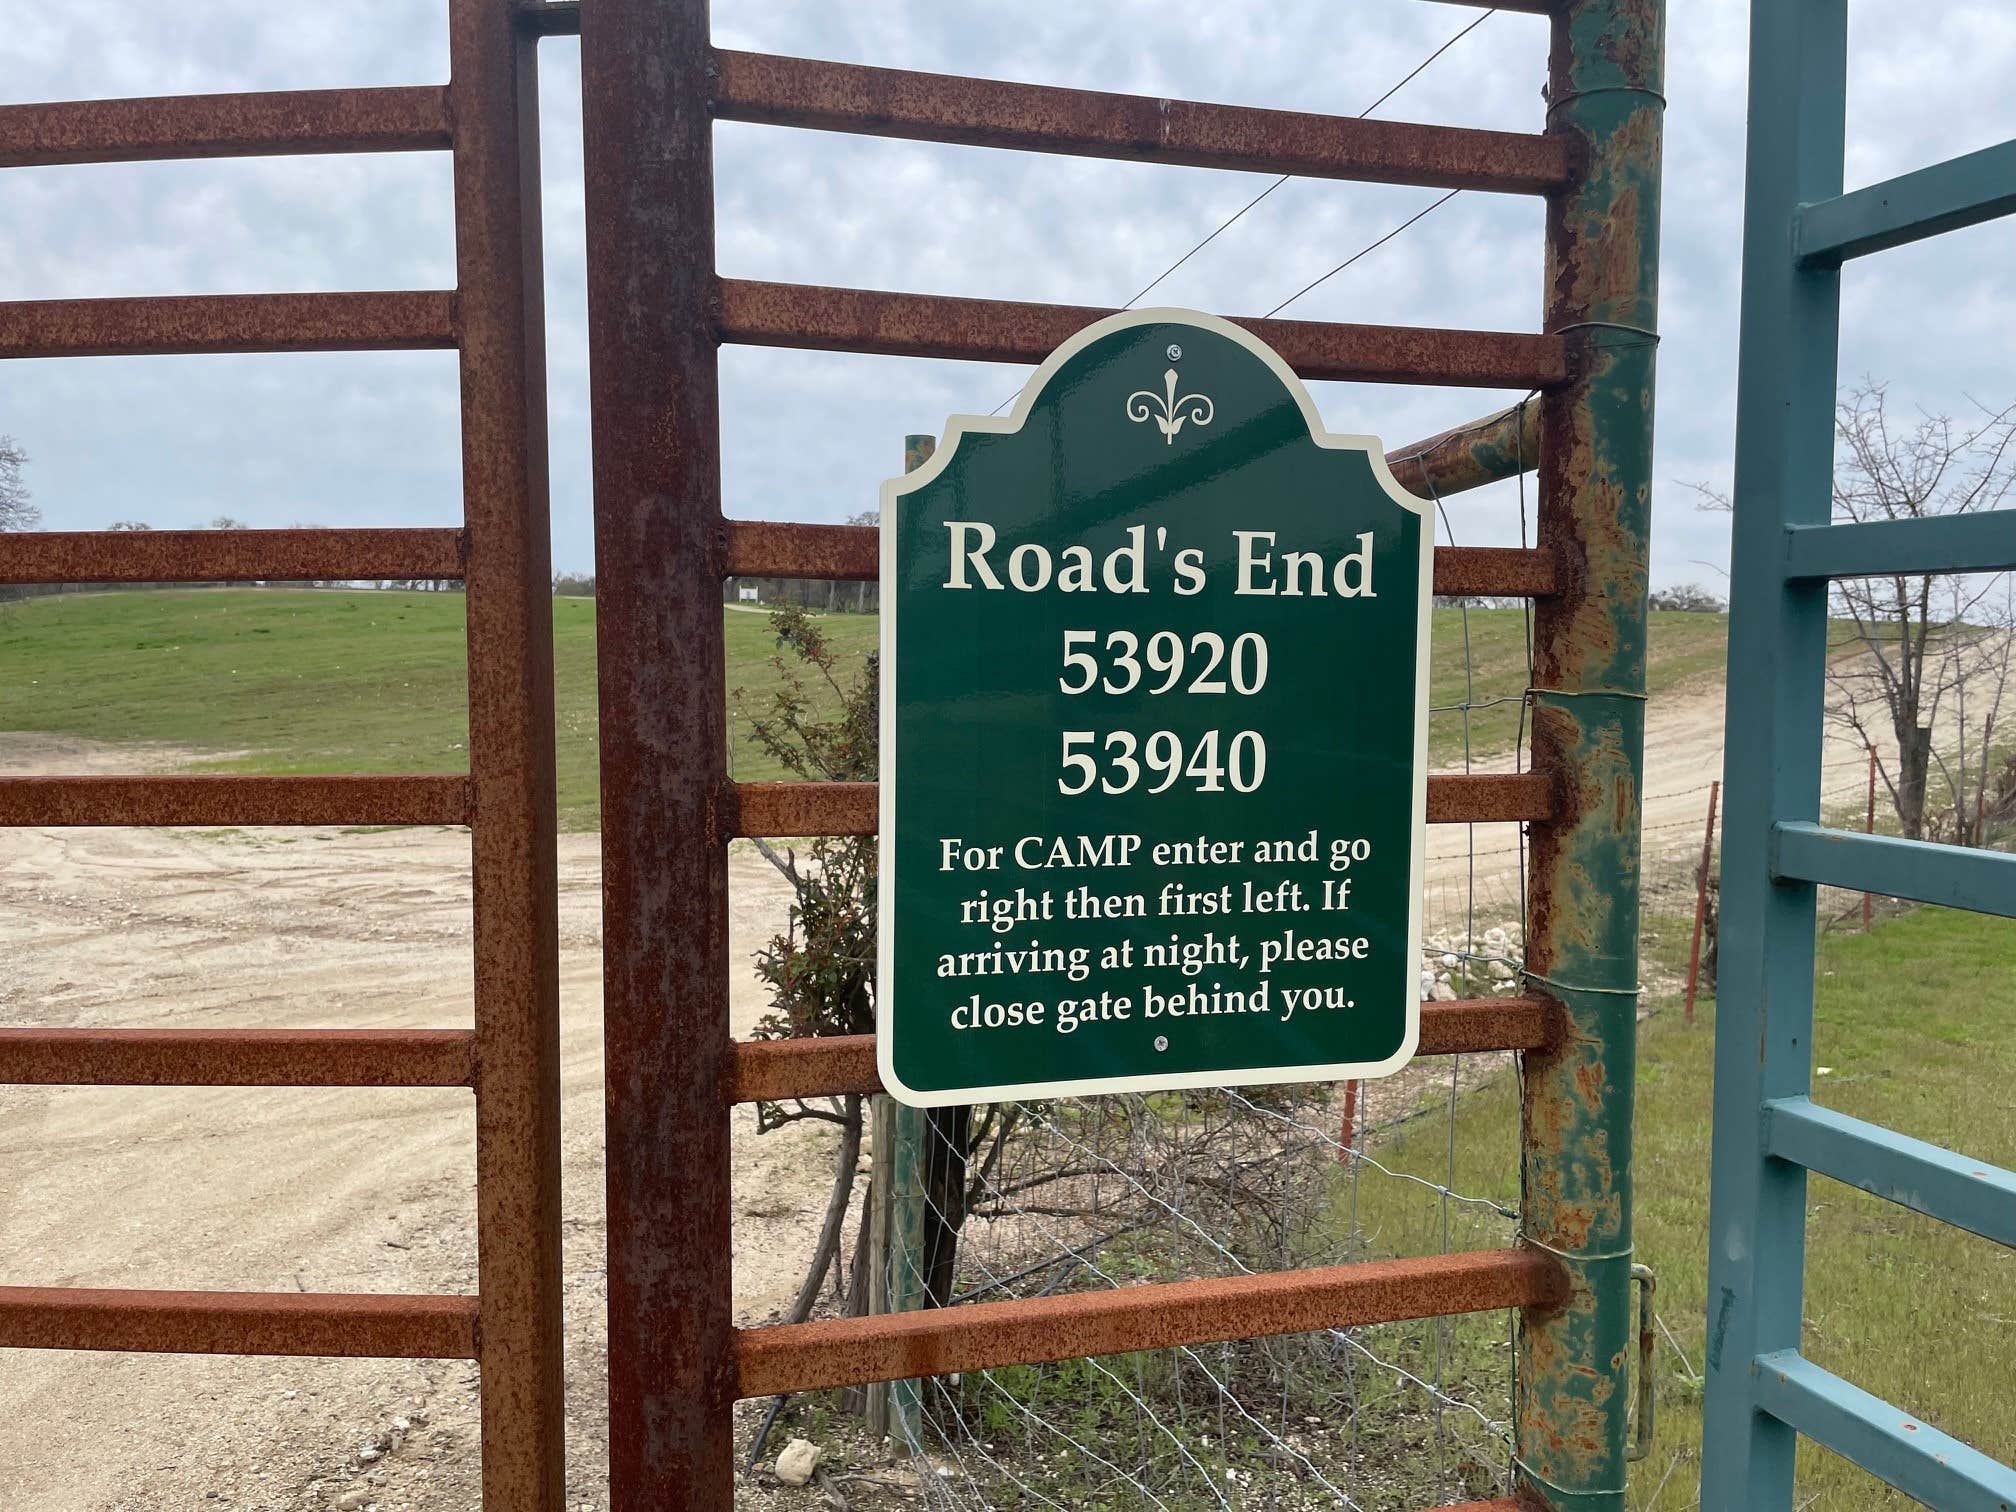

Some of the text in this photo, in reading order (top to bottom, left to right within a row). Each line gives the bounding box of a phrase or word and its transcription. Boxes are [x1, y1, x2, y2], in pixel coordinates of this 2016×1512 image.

[942, 520, 1378, 598] Road's End
[1059, 630, 1268, 696] 53920
[1057, 729, 1266, 796] 53940
[939, 829, 1371, 872] For CAMP enter and go
[960, 878, 1352, 934] right then first left. If
[937, 929, 1369, 982] arriving at night, please
[950, 979, 1355, 1034] close gate behind you.
